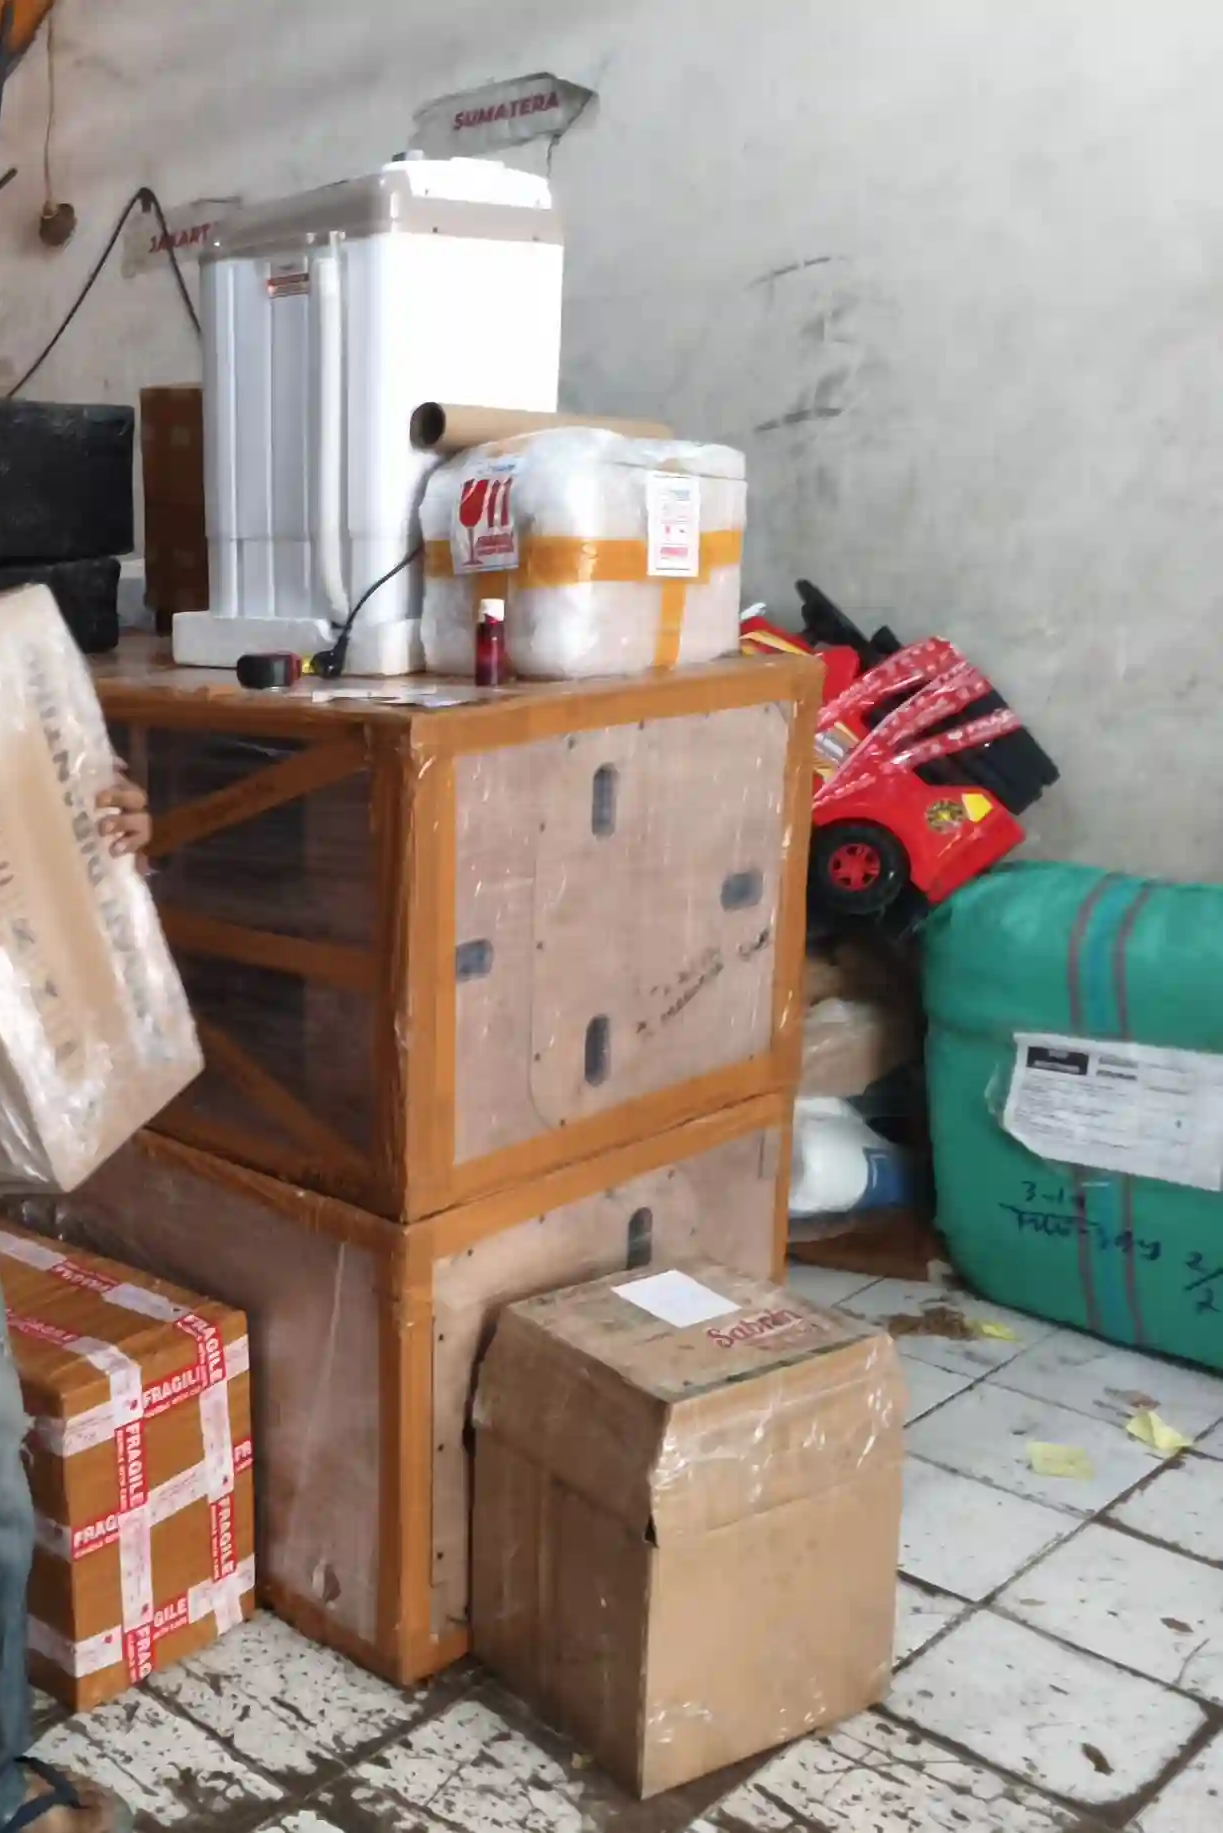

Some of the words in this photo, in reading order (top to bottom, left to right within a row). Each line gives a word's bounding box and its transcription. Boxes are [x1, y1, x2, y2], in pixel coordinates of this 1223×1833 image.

[452, 91, 561, 131] SUMATERA
[184, 1313, 225, 1384] FRAGILE
[126, 1422, 145, 1504] FRAGILE
[218, 1494, 235, 1575] FRAGILE
